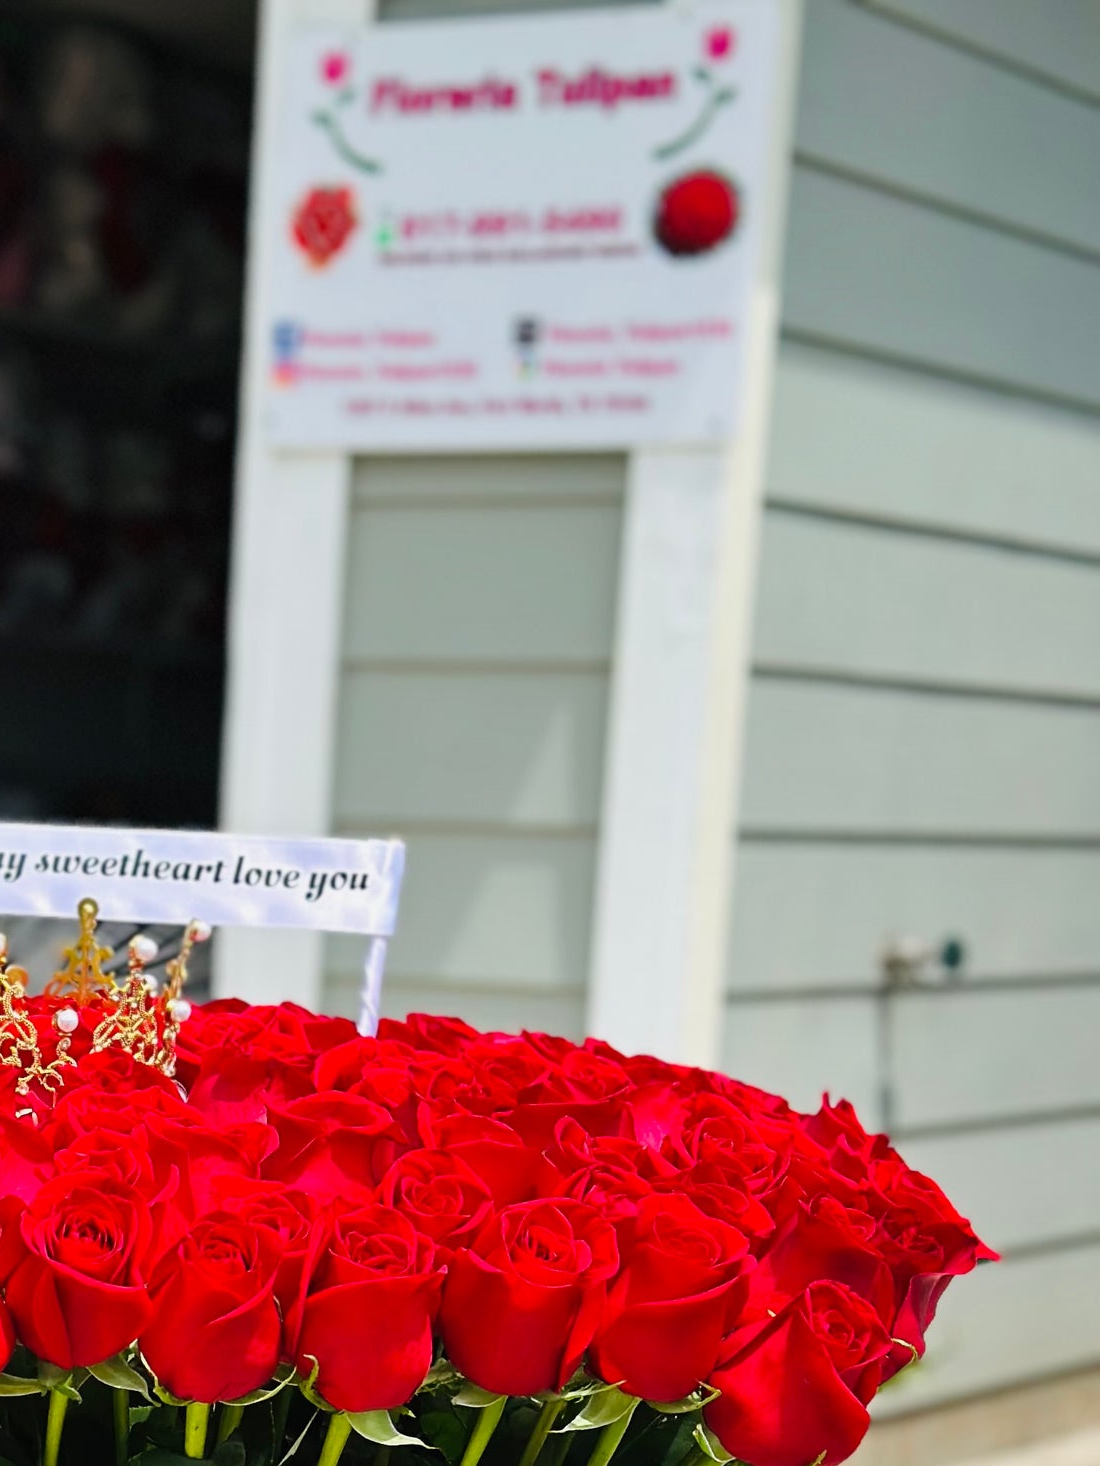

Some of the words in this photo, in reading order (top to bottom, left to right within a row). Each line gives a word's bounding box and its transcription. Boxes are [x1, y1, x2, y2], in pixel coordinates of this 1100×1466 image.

[34, 849, 226, 884] sweetheart
[233, 856, 301, 888] love
[305, 869, 370, 901] you
